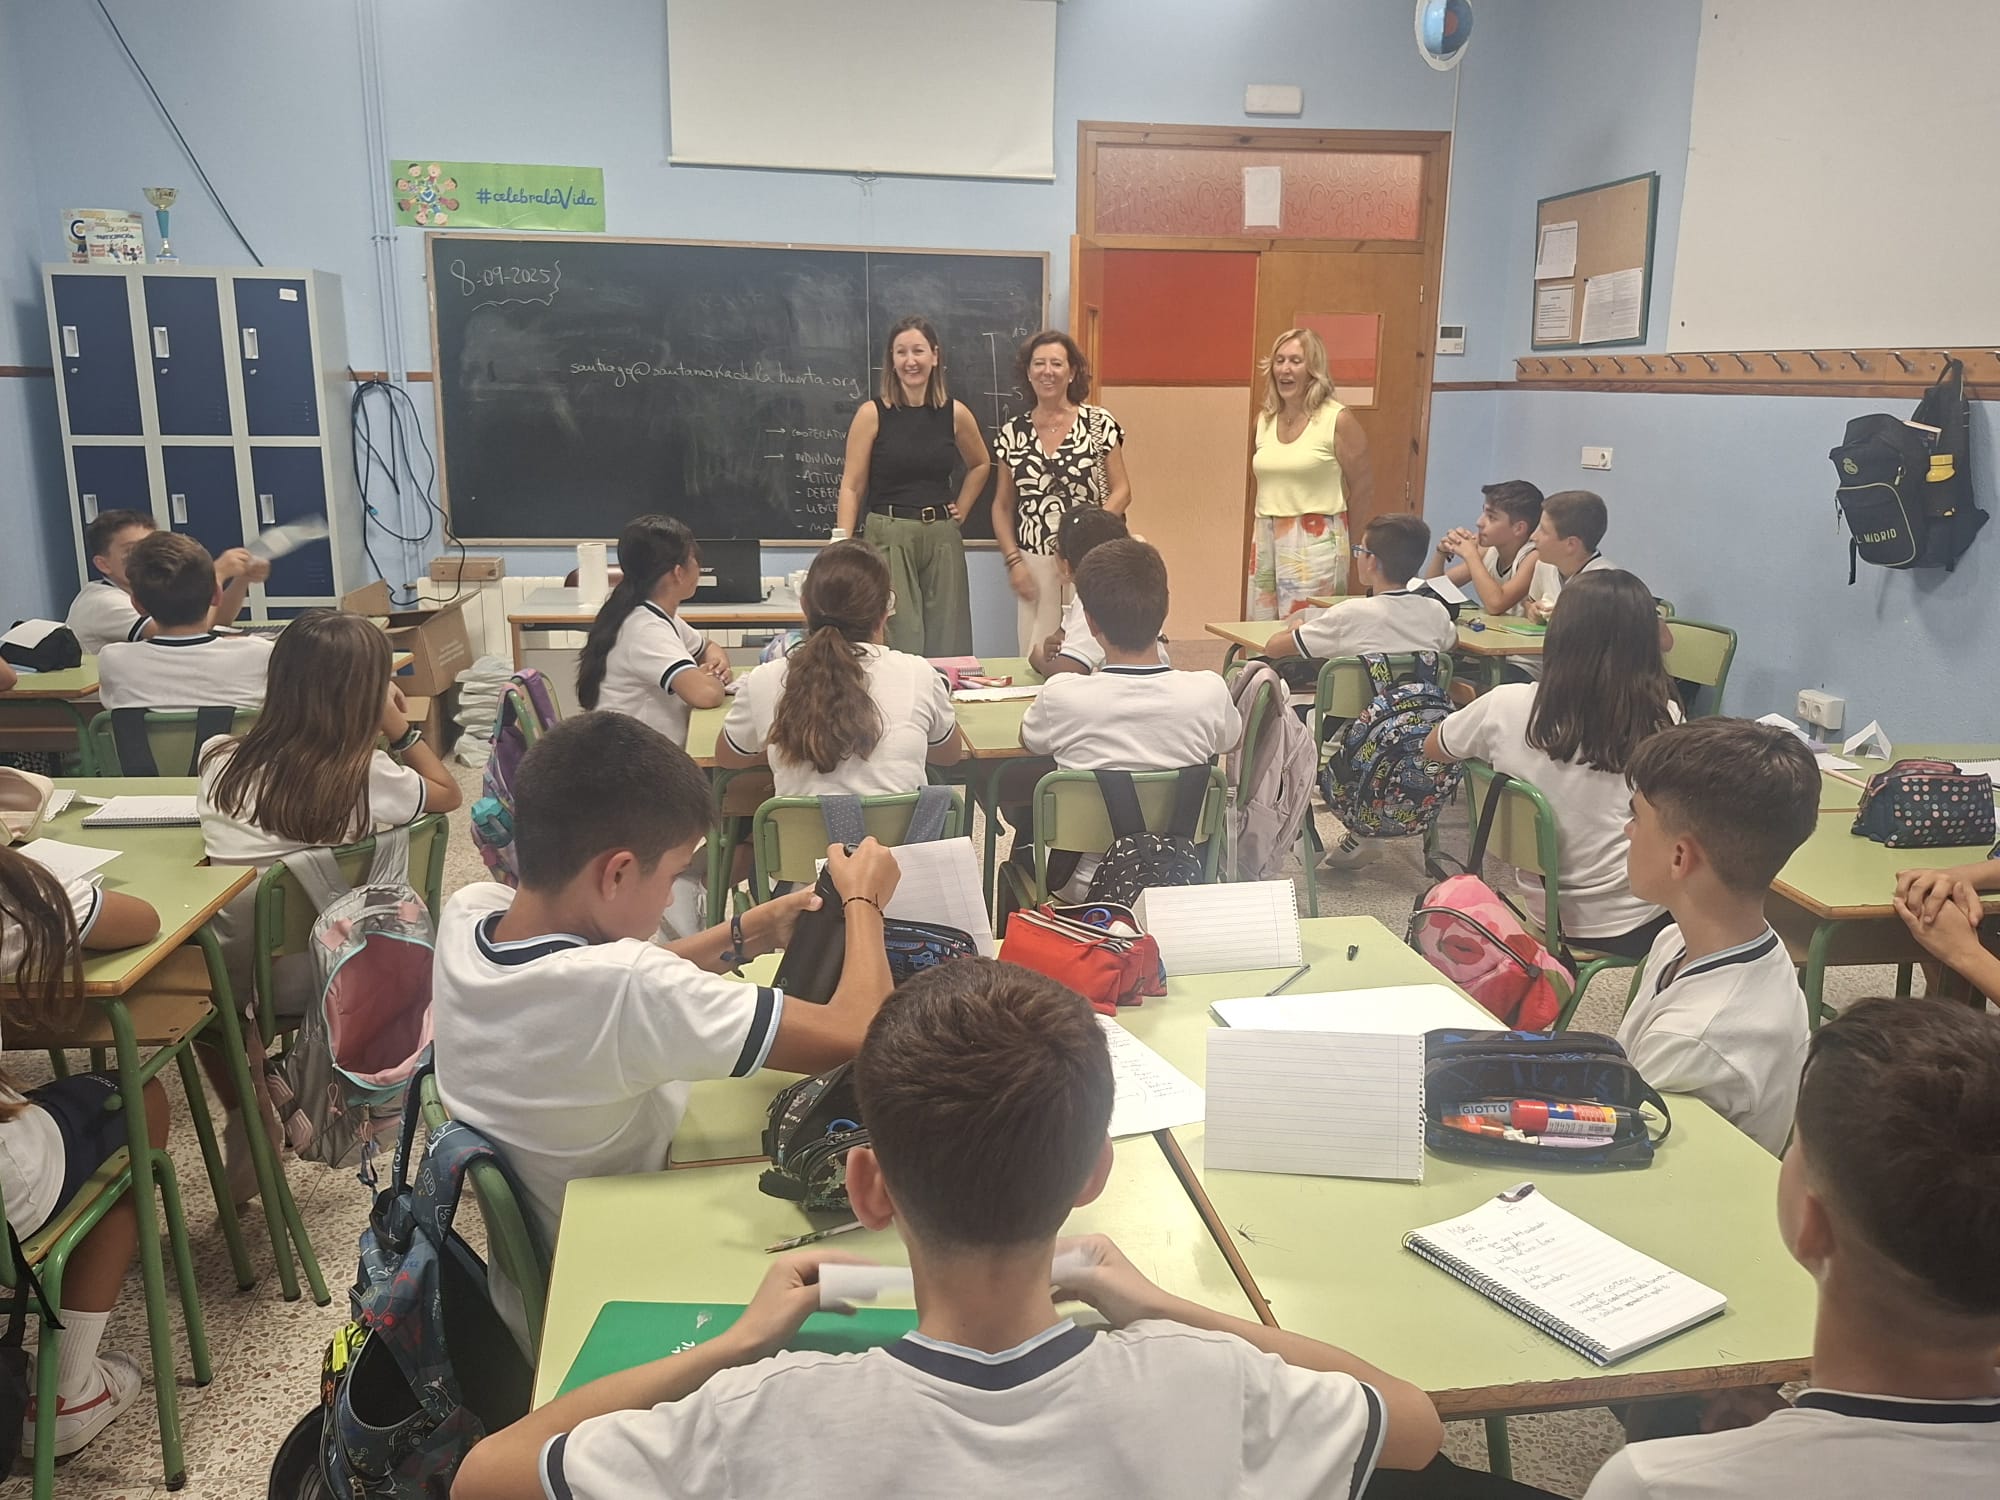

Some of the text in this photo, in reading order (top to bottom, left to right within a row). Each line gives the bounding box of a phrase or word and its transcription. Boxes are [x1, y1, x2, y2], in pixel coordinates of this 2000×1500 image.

[476, 186, 598, 209] #celebralaVida
[1863, 528, 1897, 543] MADRID
[1462, 1104, 1508, 1114] GIOTTO
